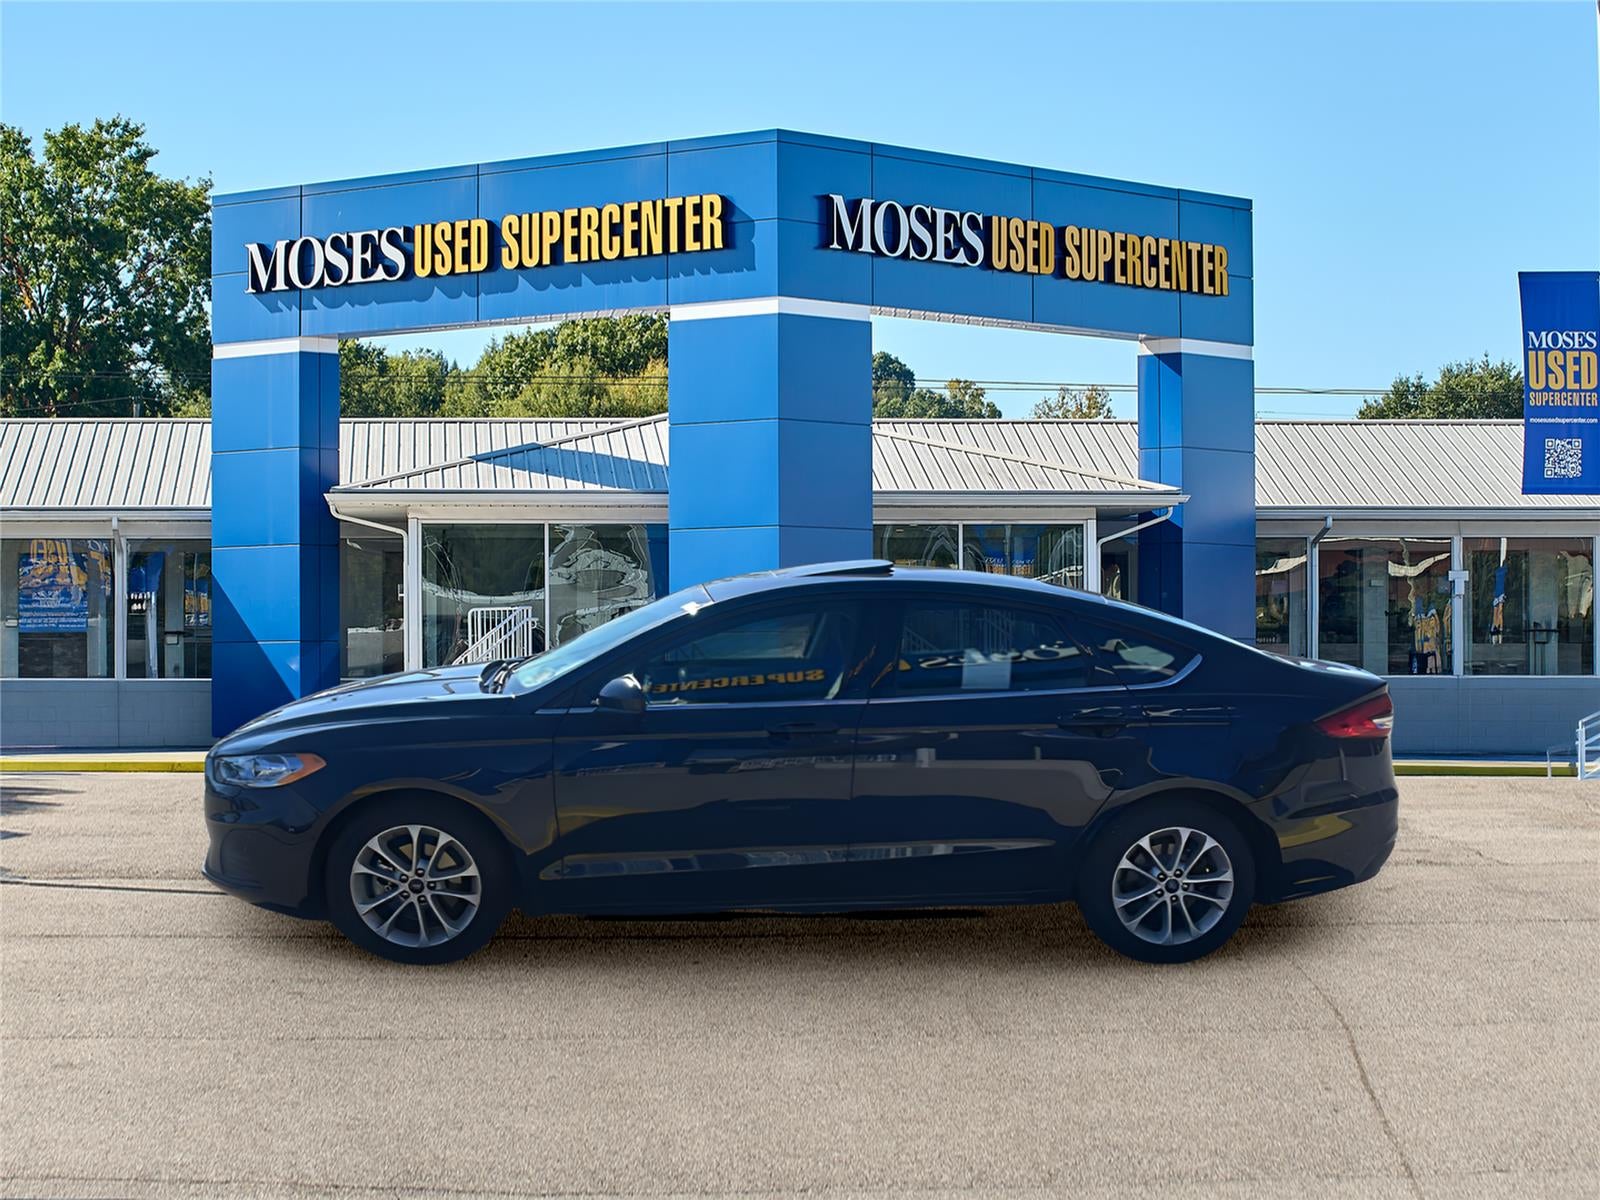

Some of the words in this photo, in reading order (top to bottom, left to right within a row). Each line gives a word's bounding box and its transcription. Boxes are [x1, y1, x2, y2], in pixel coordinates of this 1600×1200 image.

[245, 227, 408, 294] MOSES
[413, 218, 489, 279] USED
[500, 193, 725, 270] SUPERCENTER
[828, 193, 985, 267] MOSES
[990, 215, 1056, 276] USED
[1064, 224, 1230, 297] SUPERCENTER
[1528, 331, 1597, 349] MOSES
[1528, 350, 1598, 390] USED
[1529, 391, 1598, 407] SUPERCENTER
